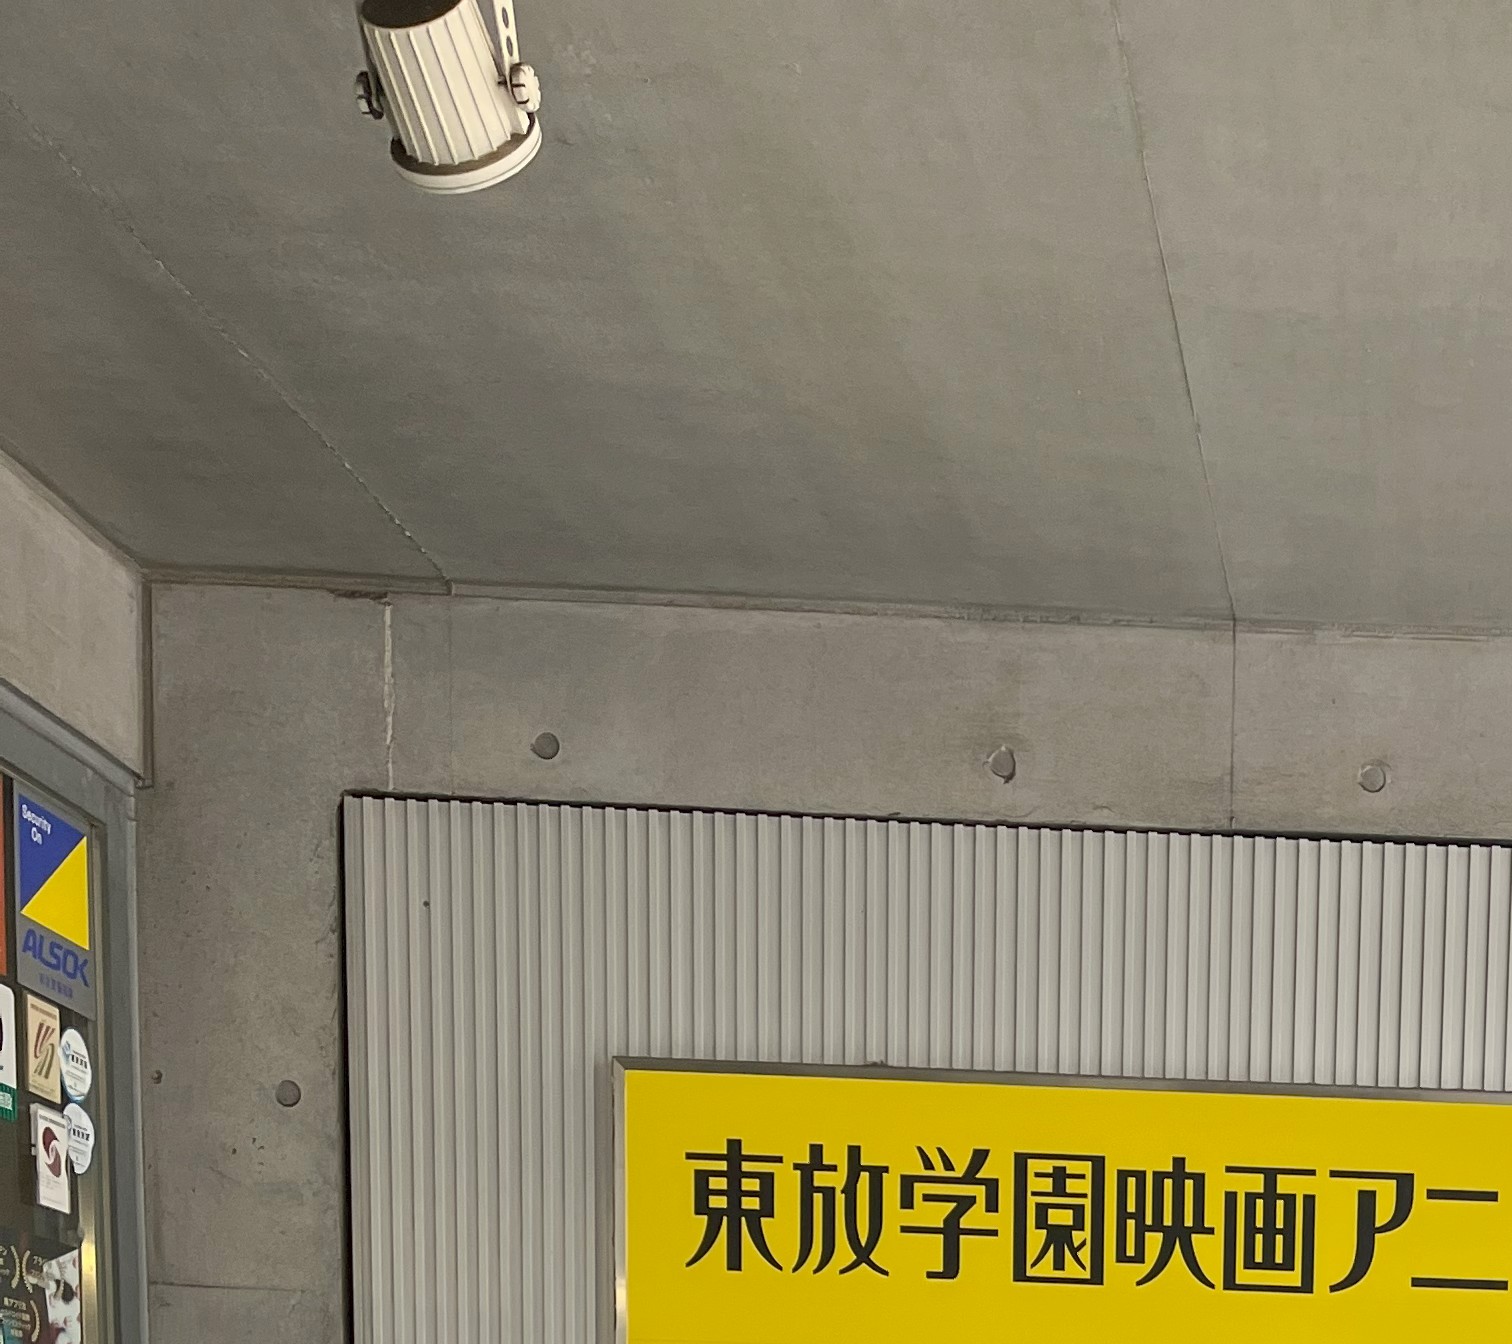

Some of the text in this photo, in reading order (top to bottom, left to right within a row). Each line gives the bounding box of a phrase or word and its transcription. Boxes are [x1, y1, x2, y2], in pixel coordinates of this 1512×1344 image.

[21, 803, 52, 835] Security
[30, 826, 43, 846] On
[21, 927, 91, 988] ALSOK
